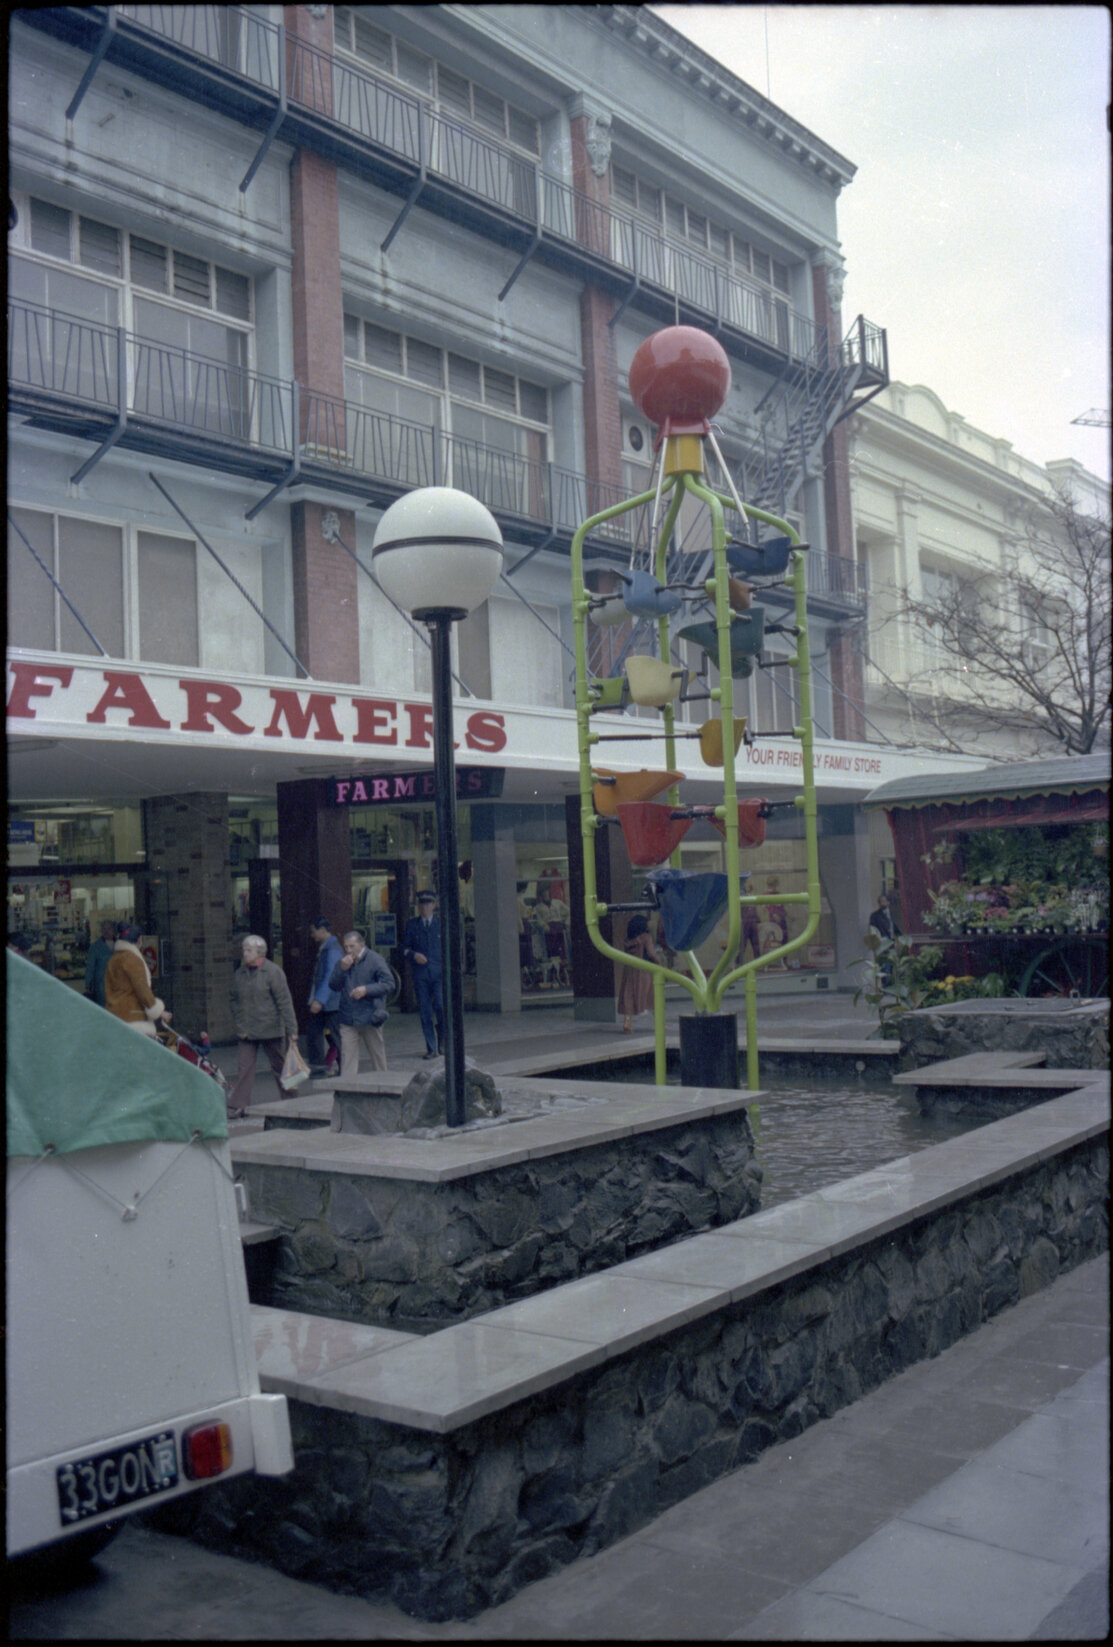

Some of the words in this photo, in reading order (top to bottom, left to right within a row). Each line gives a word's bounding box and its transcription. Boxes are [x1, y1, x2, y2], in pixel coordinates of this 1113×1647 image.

[746, 747, 774, 765] YOUR
[777, 750, 822, 768] FRIENLY
[823, 754, 853, 771] FAMILY
[854, 757, 882, 774] STORE
